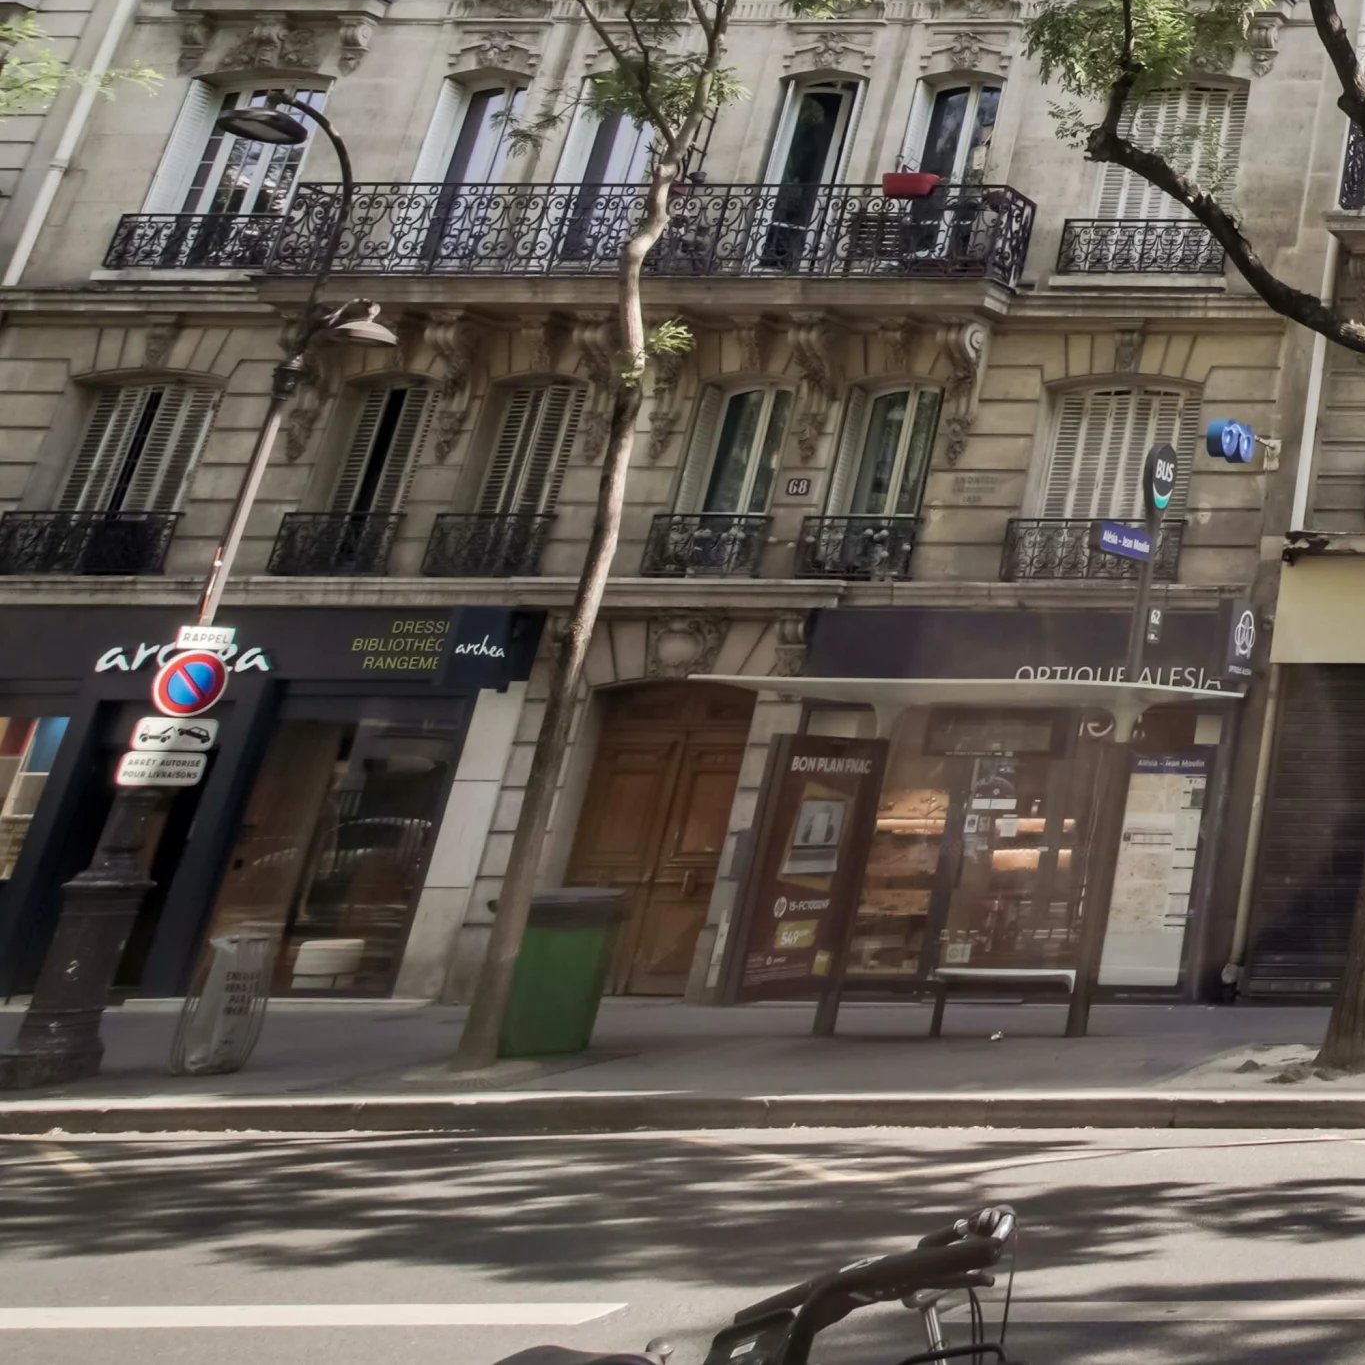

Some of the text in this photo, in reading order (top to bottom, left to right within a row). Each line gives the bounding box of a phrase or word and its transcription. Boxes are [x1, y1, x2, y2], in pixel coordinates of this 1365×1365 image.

[1155, 459, 1174, 482] BUS
[788, 480, 808, 494] 68
[1150, 609, 1162, 625] 62
[182, 632, 229, 645] RAPPEL
[455, 635, 505, 658] archea
[94, 642, 271, 672] arcea
[128, 758, 156, 768] ARRÊT
[791, 755, 873, 774] BON PLAN FNAC
[122, 770, 198, 780] POUR LIVRAISONS
